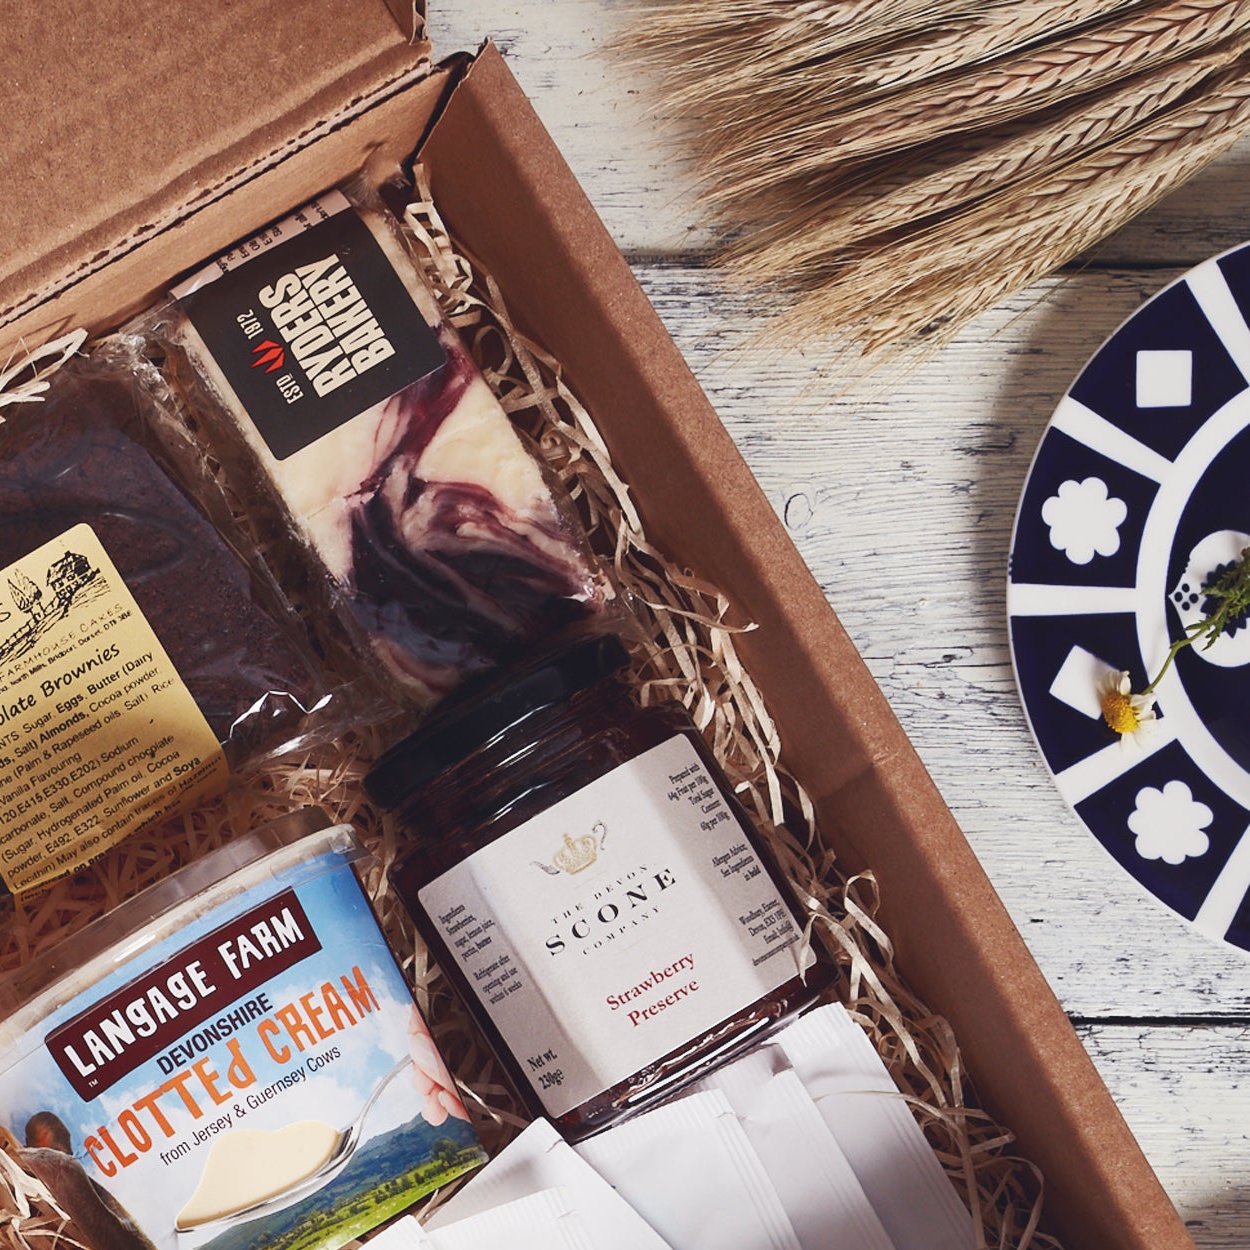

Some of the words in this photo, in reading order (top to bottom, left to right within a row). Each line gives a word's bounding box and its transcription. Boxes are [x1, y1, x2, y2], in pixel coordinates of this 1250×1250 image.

[236, 309, 264, 340] 1972
[259, 268, 356, 396] RYDERS
[296, 255, 395, 378] BAKERY
[79, 603, 123, 633] CAKES
[40, 643, 120, 698] Brownies
[86, 671, 120, 695] Butter
[121, 652, 153, 676] (Dairy
[39, 711, 90, 744] Almonds,
[88, 690, 123, 713] Cocoa
[13, 757, 43, 780] (Palm
[42, 749, 53, 761] &
[51, 719, 103, 755] Rapeseed
[29, 752, 83, 787] Flavouring
[100, 737, 139, 763] Sodium
[36, 793, 104, 840] Hydrogenated
[102, 780, 130, 800] Palm
[146, 751, 181, 774] Cocoa
[72, 761, 127, 799] Compound
[103, 785, 150, 818] Sunflower
[153, 771, 173, 789] and
[172, 757, 204, 777] Soya
[55, 848, 78, 865] May
[79, 836, 101, 852] also
[101, 810, 135, 839] contain
[545, 869, 676, 956] SCONE
[553, 905, 583, 924] THE
[594, 866, 647, 900] DEVON
[218, 908, 304, 979] FARM
[582, 907, 659, 955] COMPANY
[606, 956, 694, 1011] Strawberry
[627, 981, 698, 1027] Preserve
[151, 993, 273, 1075] DEVONSHIRE
[258, 967, 380, 1063] CREAM
[526, 1055, 546, 1072] Net
[542, 1048, 558, 1062] wt.
[159, 1141, 191, 1166] from
[192, 1113, 233, 1146] Jersey
[233, 1104, 247, 1119] &
[246, 1066, 306, 1110] Guernsey
[306, 1046, 341, 1073] Cows
